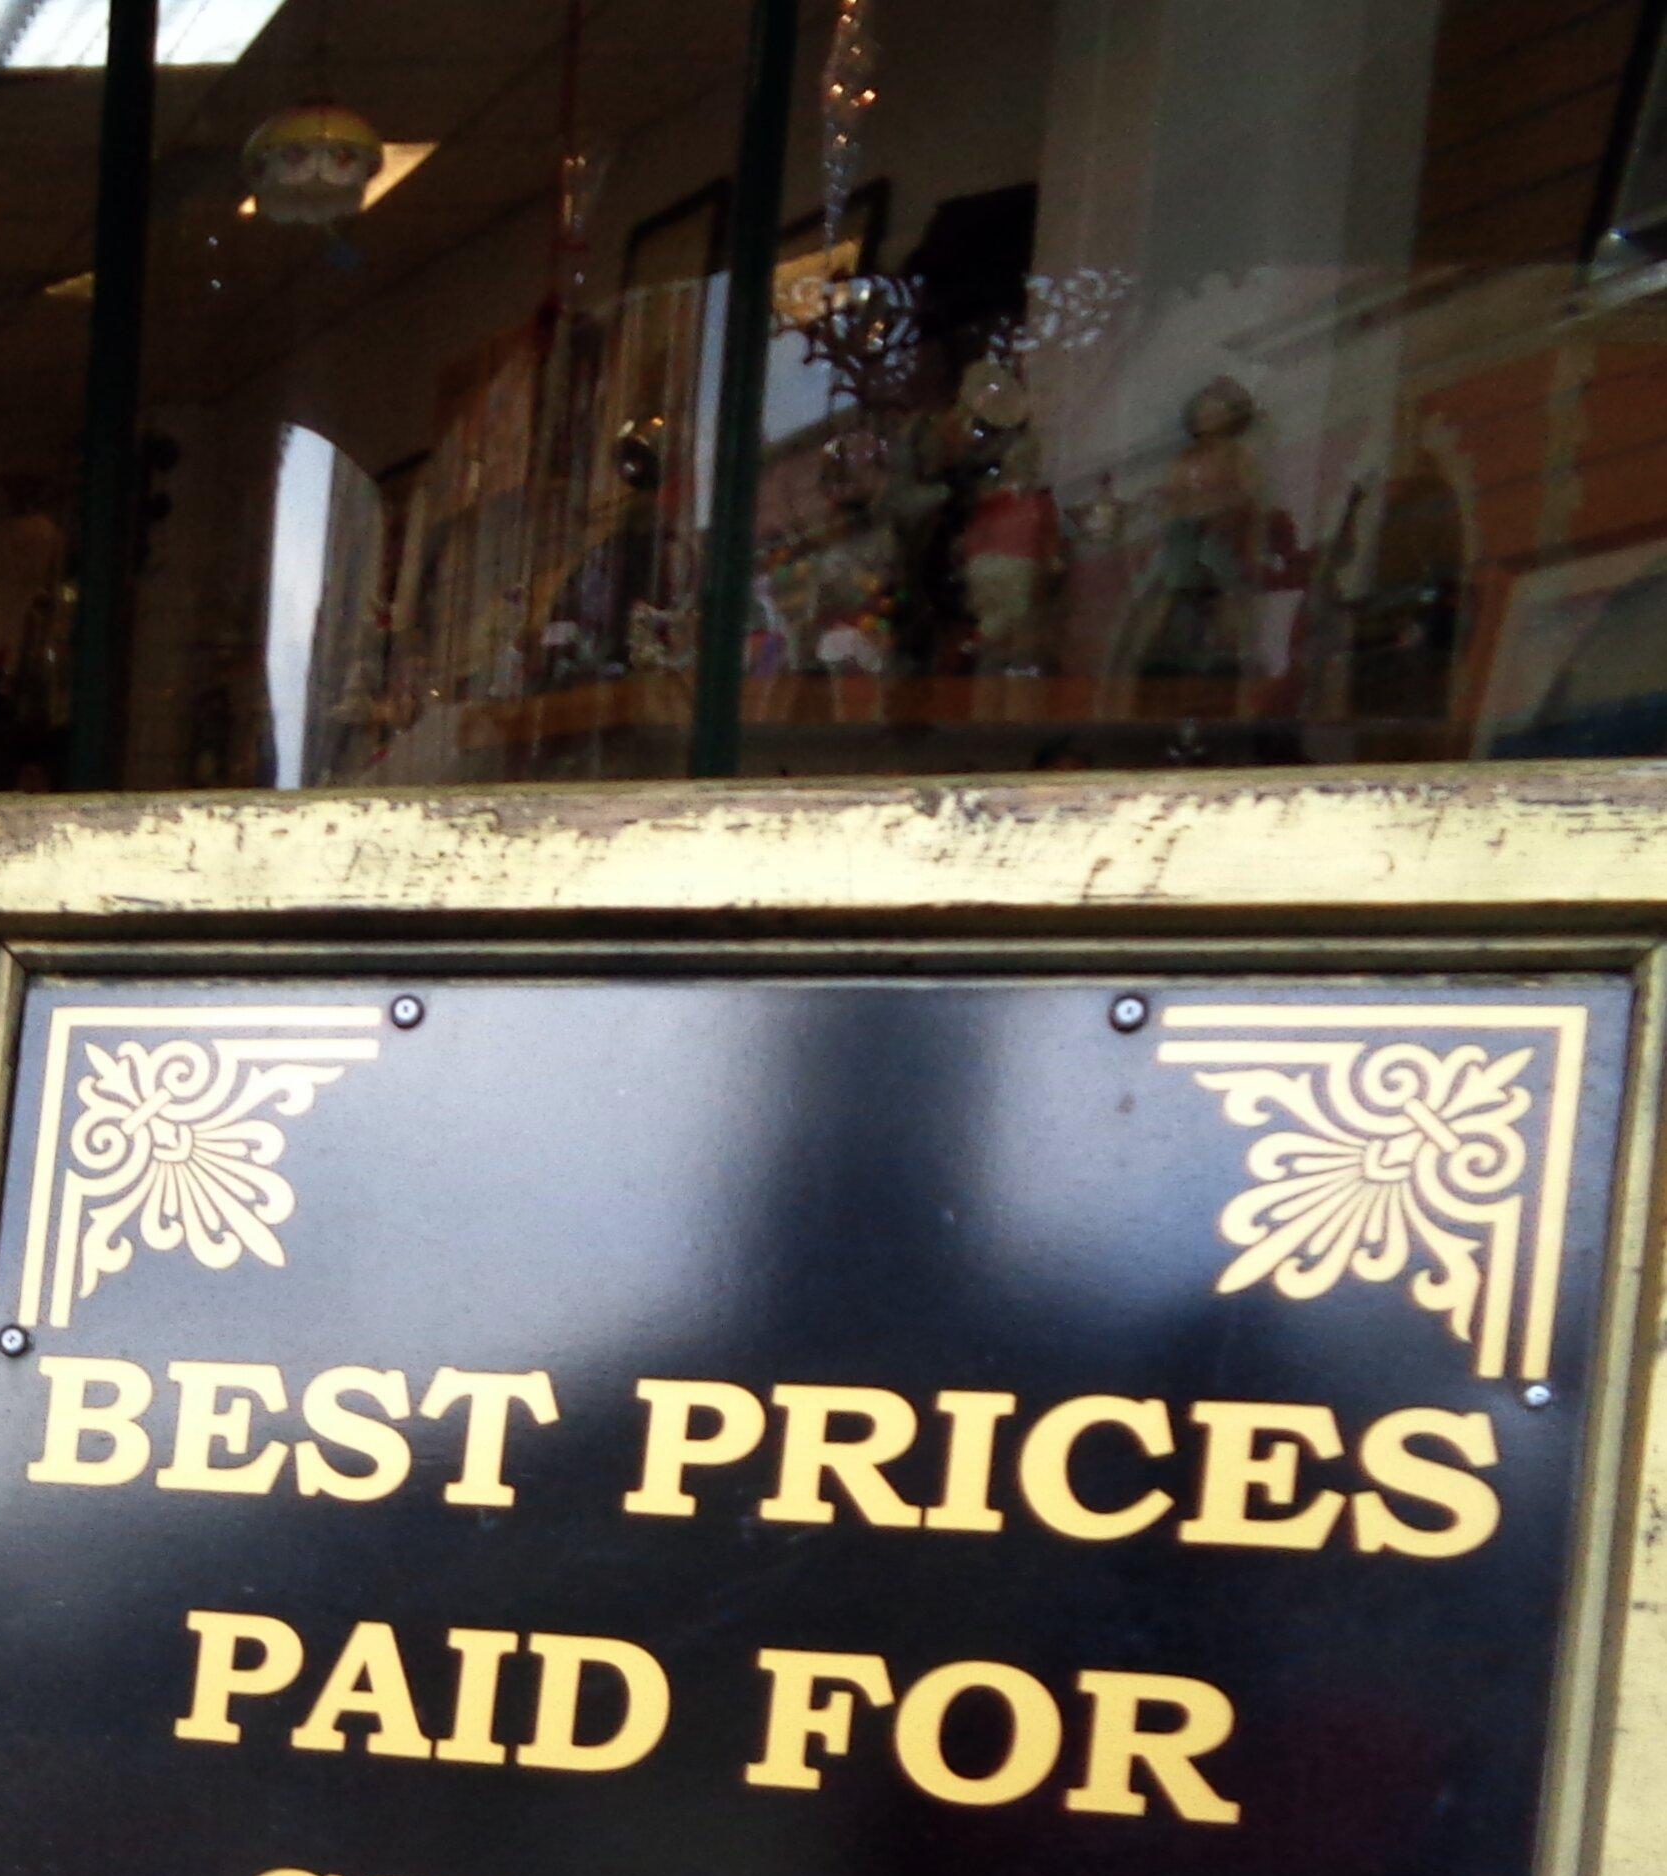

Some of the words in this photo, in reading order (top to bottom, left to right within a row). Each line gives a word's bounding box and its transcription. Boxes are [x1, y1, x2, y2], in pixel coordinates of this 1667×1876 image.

[27, 1354, 558, 1510] BEST
[623, 1378, 1503, 1558] PRICES
[174, 1609, 671, 1774] PAID
[745, 1648, 1240, 1825] FOR
